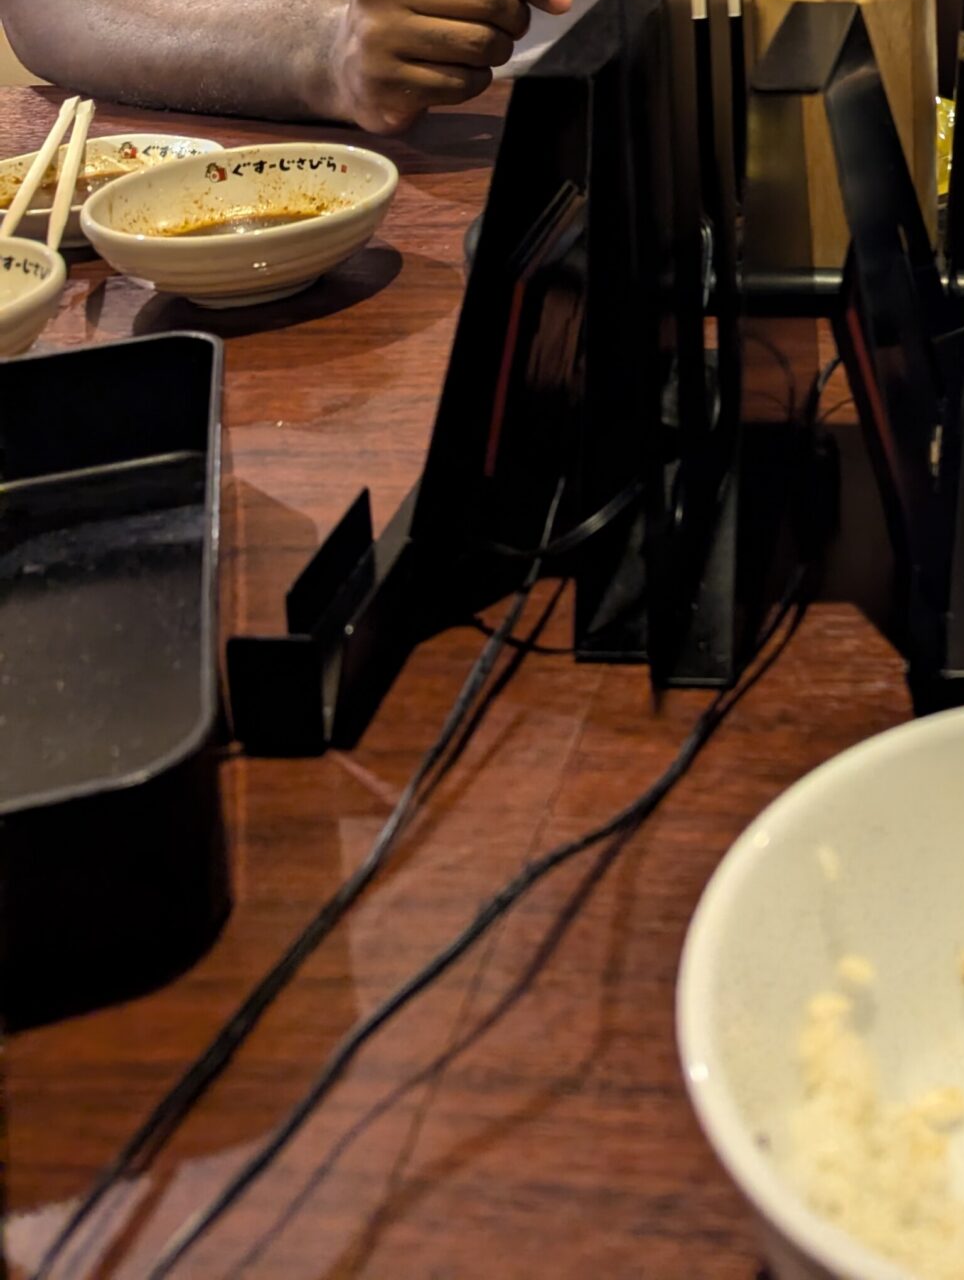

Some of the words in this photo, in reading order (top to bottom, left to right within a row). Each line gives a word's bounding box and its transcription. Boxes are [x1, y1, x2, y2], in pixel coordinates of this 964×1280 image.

[231, 156, 337, 176] ぐすーじさびら
